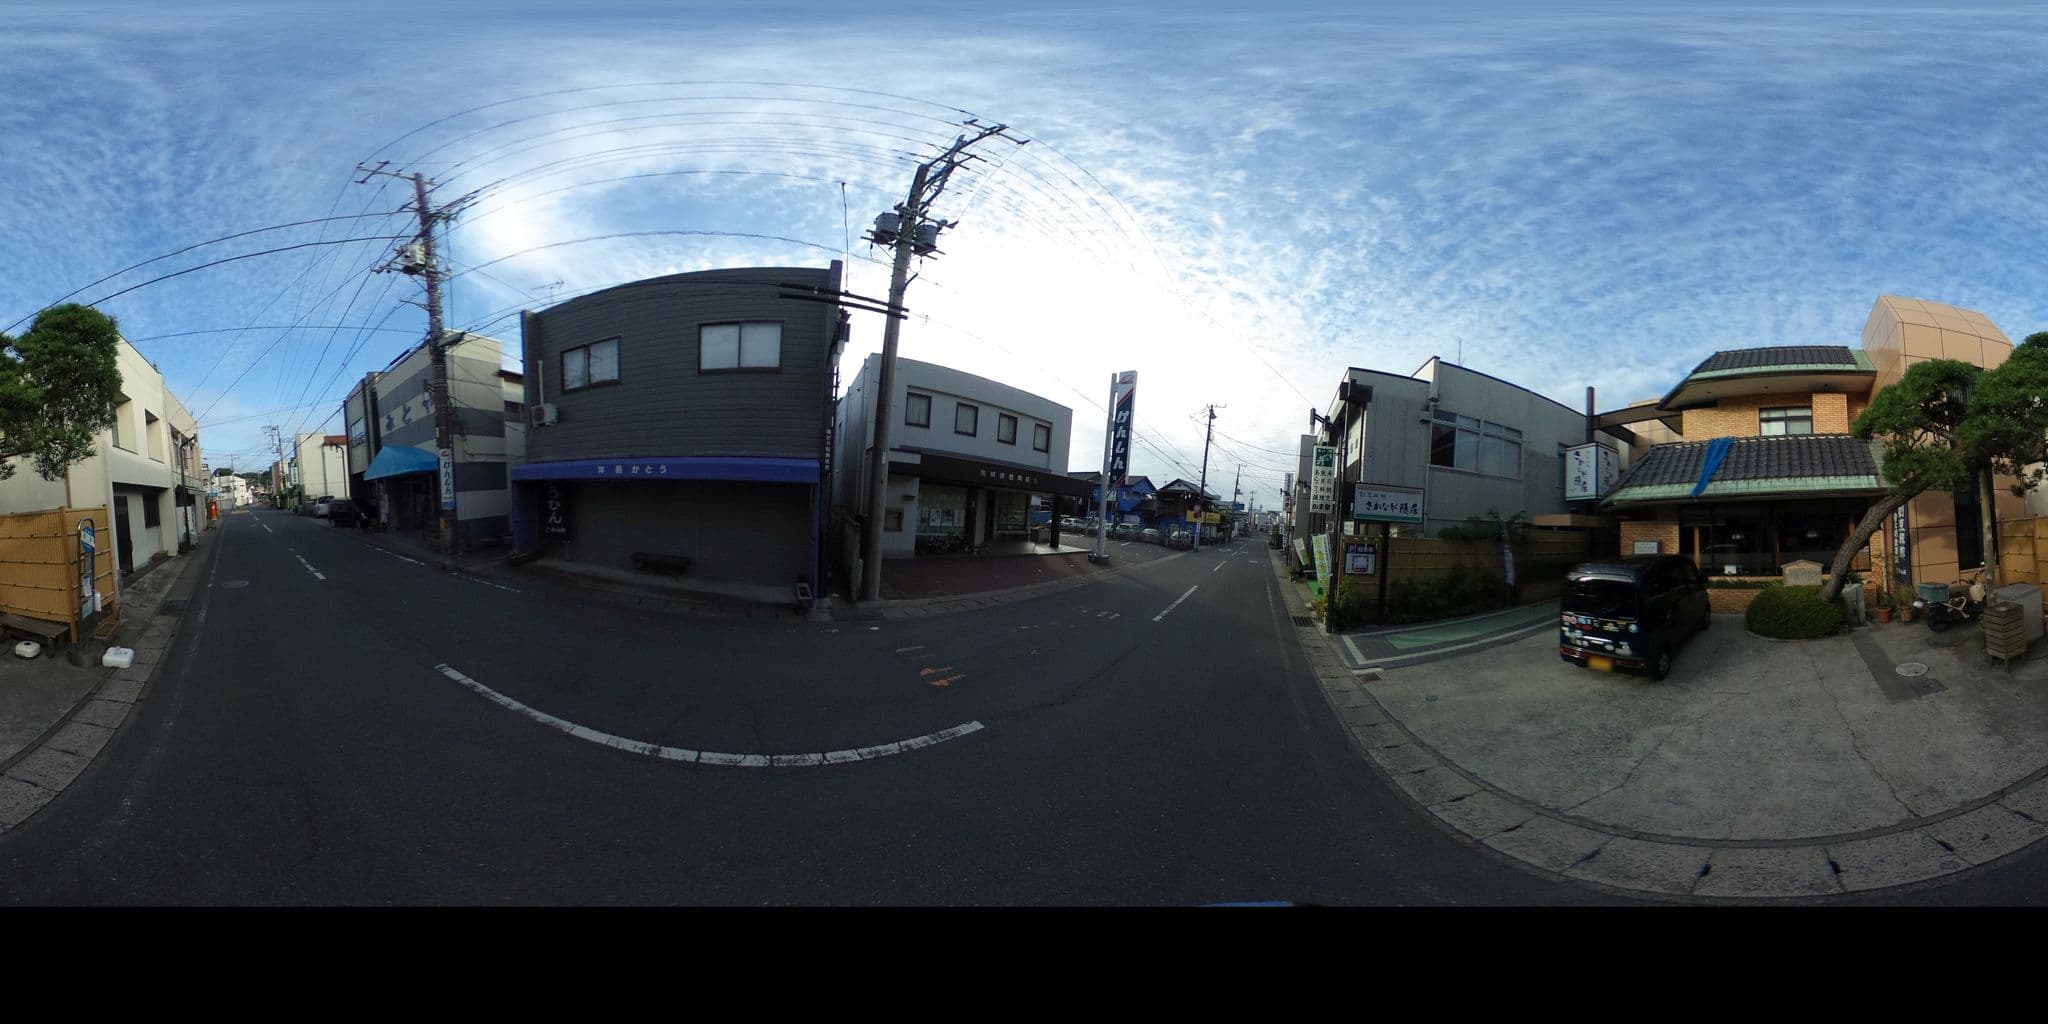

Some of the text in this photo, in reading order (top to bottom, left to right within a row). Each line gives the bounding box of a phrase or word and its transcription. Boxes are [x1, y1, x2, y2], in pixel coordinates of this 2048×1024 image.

[1112, 410, 1129, 470] けんしん
[443, 460, 452, 494] けんしん
